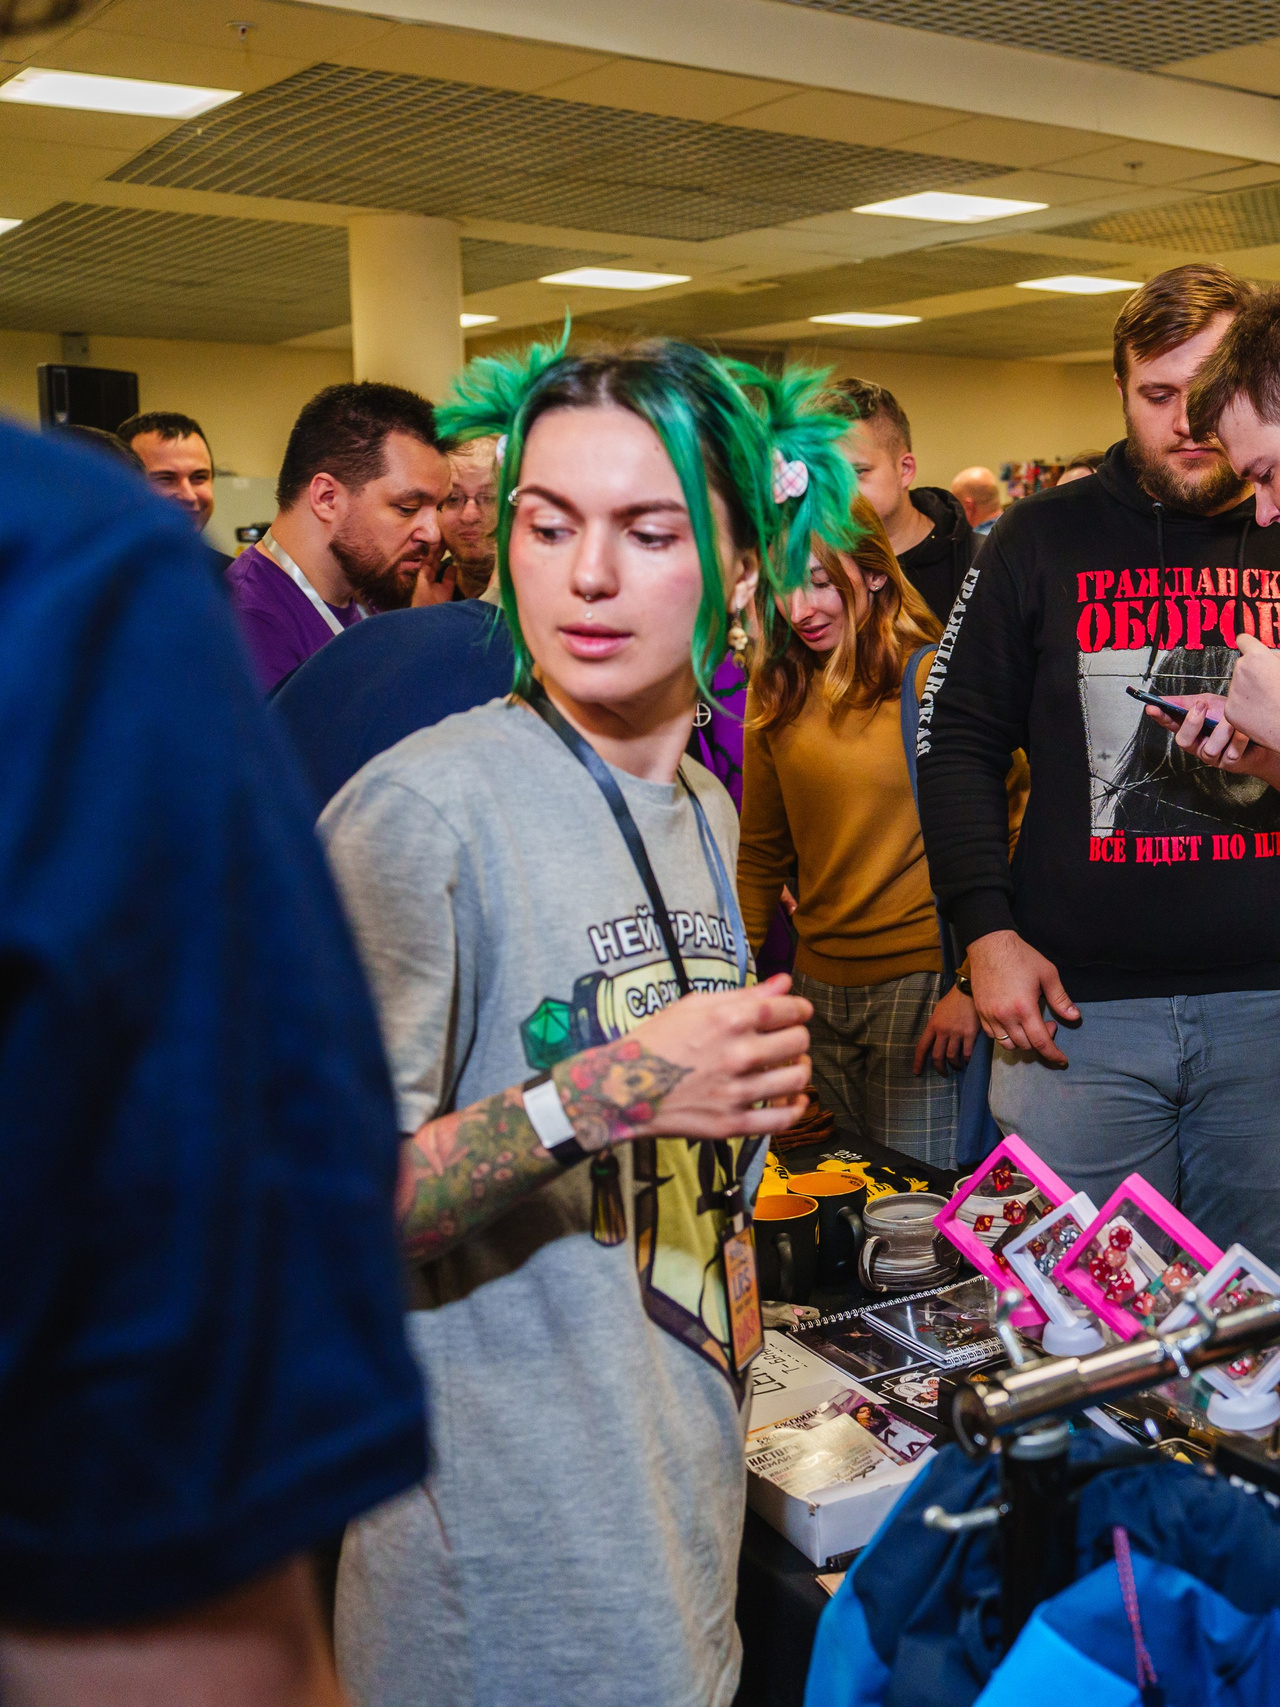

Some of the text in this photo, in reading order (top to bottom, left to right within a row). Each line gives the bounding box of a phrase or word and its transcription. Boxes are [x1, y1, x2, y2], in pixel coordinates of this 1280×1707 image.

[1089, 830, 1126, 862] ВСЁ
[1135, 833, 1202, 867] ИДЕТ
[1212, 833, 1246, 861] ПО
